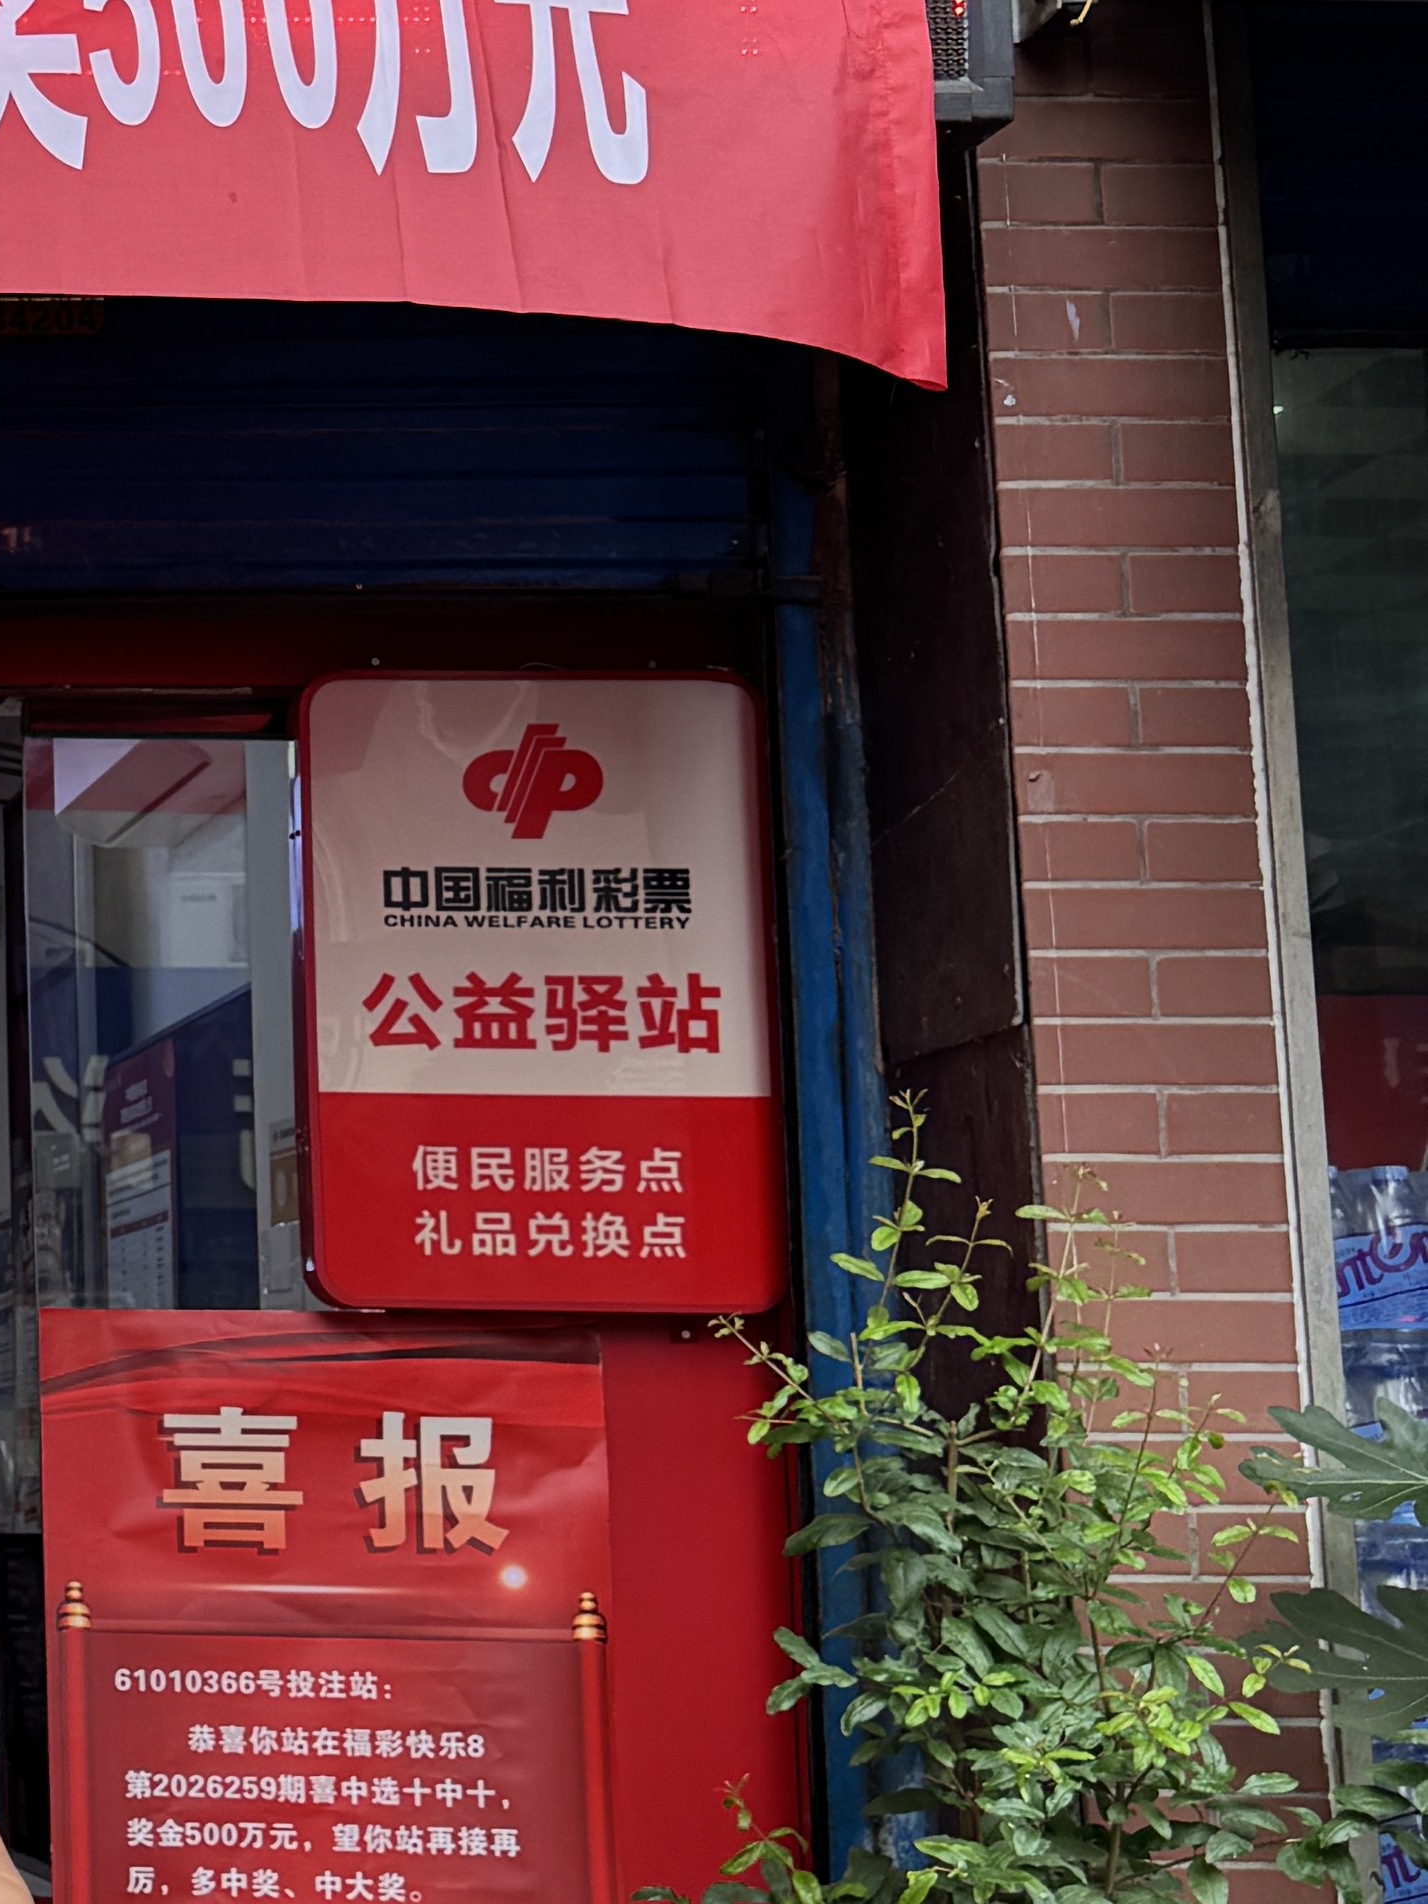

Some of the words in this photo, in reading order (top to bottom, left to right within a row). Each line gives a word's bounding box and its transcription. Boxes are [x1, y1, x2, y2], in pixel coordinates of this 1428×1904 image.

[383, 866, 693, 914] 中国福利彩票
[383, 915, 459, 928] CHINA
[463, 915, 577, 929] WELFARE
[582, 916, 691, 931] LOTTERY
[361, 972, 723, 1054] 公益驿站
[412, 1144, 685, 1194] 便民服务点
[413, 1209, 688, 1259] 礼品兑换点
[162, 1404, 512, 1556] 喜报
[187, 1723, 486, 1760] 恭喜你站在福彩快乐8
